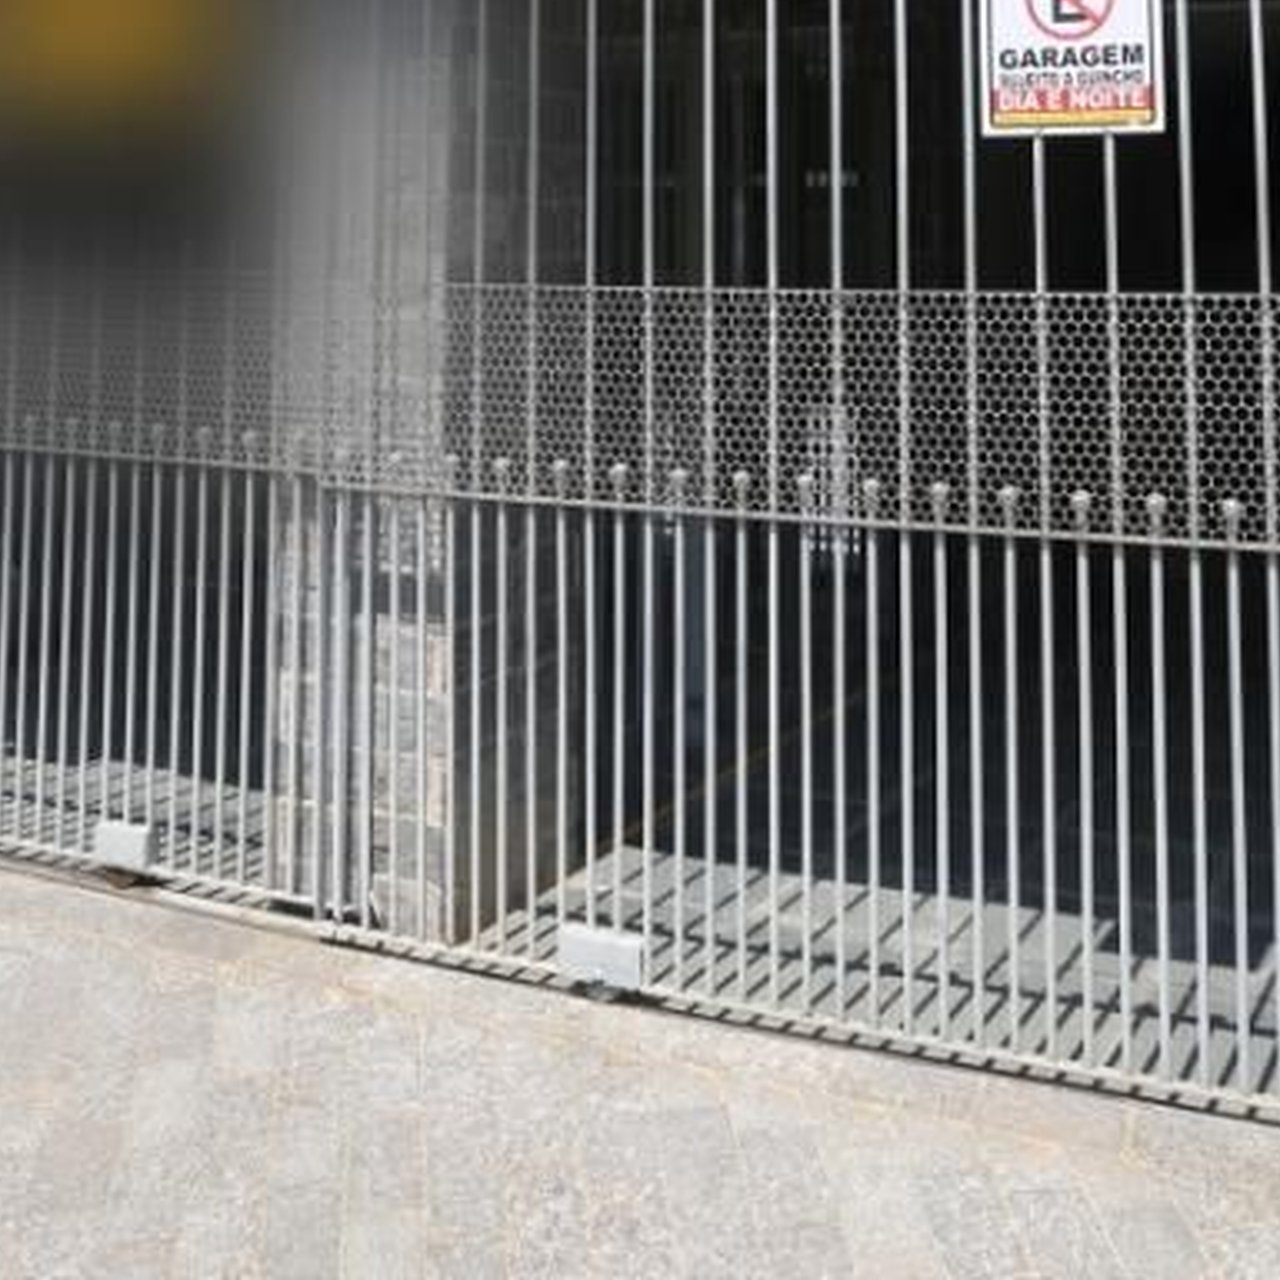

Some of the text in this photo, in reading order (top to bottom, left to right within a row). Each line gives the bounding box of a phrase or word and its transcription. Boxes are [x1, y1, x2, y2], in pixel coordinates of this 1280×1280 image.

[999, 44, 1144, 70] GARAGEM
[999, 86, 1147, 110] DIA E NOITE
